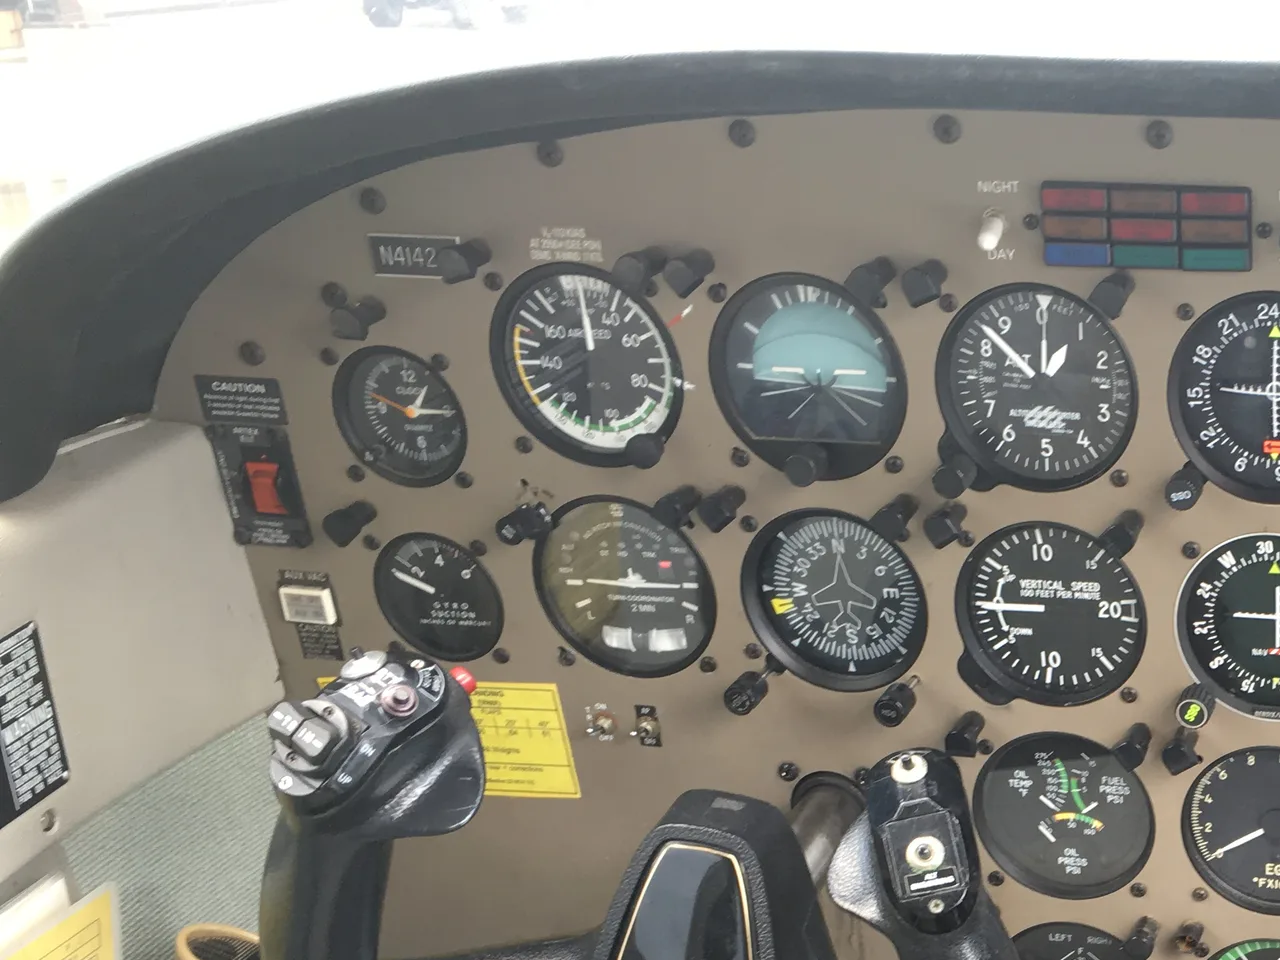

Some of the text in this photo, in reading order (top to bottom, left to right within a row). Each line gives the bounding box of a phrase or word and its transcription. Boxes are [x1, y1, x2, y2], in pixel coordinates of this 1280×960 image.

[977, 182, 1018, 193] NIGHT
[379, 246, 438, 268] N4142
[987, 250, 1015, 261] DAY
[1257, 303, 1280, 319] 24
[544, 326, 565, 338] 160
[541, 357, 562, 369] 140
[212, 382, 266, 393] CAUTION
[604, 409, 619, 418] 100
[1256, 541, 1274, 553] 30
[1033, 545, 1053, 561] 10
[1019, 579, 1100, 591] VERTICAL SPEED
[1021, 589, 1101, 600] 100 FEET PER MINUTE
[431, 610, 476, 619] SUCTION
[1098, 601, 1121, 618] 20
[1010, 627, 1033, 635] DOWN
[1041, 651, 1061, 667] 10
[360, 744, 376, 756] DN
[338, 772, 352, 784] UP
[1014, 770, 1029, 779] OIL
[1008, 779, 1033, 788] TEMP
[1101, 777, 1127, 785] FUEL
[1099, 786, 1130, 795] PRESS
[1107, 795, 1124, 804] PSI
[1064, 848, 1079, 856] OIL
[1058, 857, 1088, 866] PRESS
[1065, 866, 1081, 874] PSI
[1049, 934, 1072, 942] LEFT
